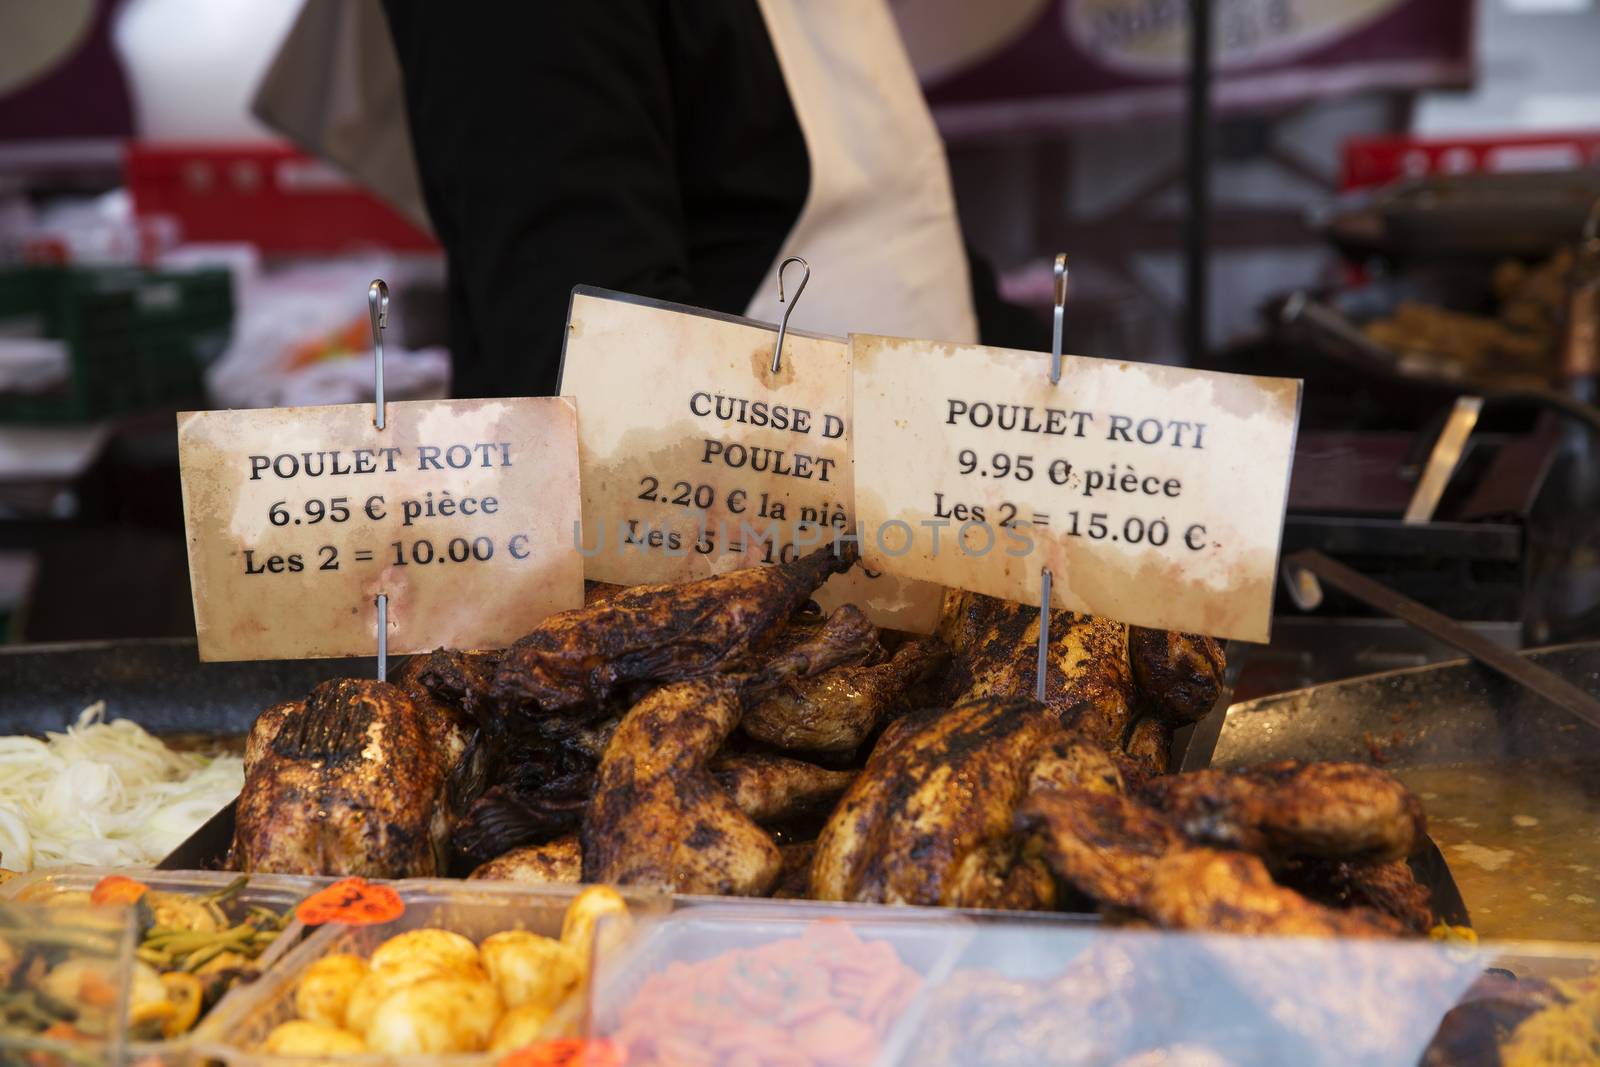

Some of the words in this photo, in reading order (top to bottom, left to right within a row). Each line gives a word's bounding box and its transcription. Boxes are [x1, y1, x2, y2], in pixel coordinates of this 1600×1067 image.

[690, 392, 811, 434] CUISSE
[946, 399, 1094, 438] POULET
[1106, 414, 1208, 449] ROTI
[249, 447, 401, 480] POULET
[417, 442, 513, 471] ROTI
[701, 440, 835, 482] POULET
[958, 450, 1034, 481] 9.95
[1047, 459, 1071, 485] €
[1083, 464, 1182, 499] pièce
[269, 497, 351, 526] 6.95
[364, 495, 386, 520] €
[402, 491, 499, 526] pièce
[638, 477, 715, 509] 2.20
[726, 489, 747, 514] €
[758, 494, 787, 521] la
[623, 520, 681, 550] Les
[694, 530, 715, 555] 5
[934, 493, 985, 523] Les
[998, 503, 1018, 530] 2
[1031, 513, 1050, 526] =
[1066, 511, 1169, 546] 15.00
[1184, 524, 1208, 551] €
[244, 549, 304, 575] Les
[319, 545, 339, 571] 2
[355, 549, 373, 562] =
[391, 536, 494, 566] 10.00
[508, 534, 531, 559] €
